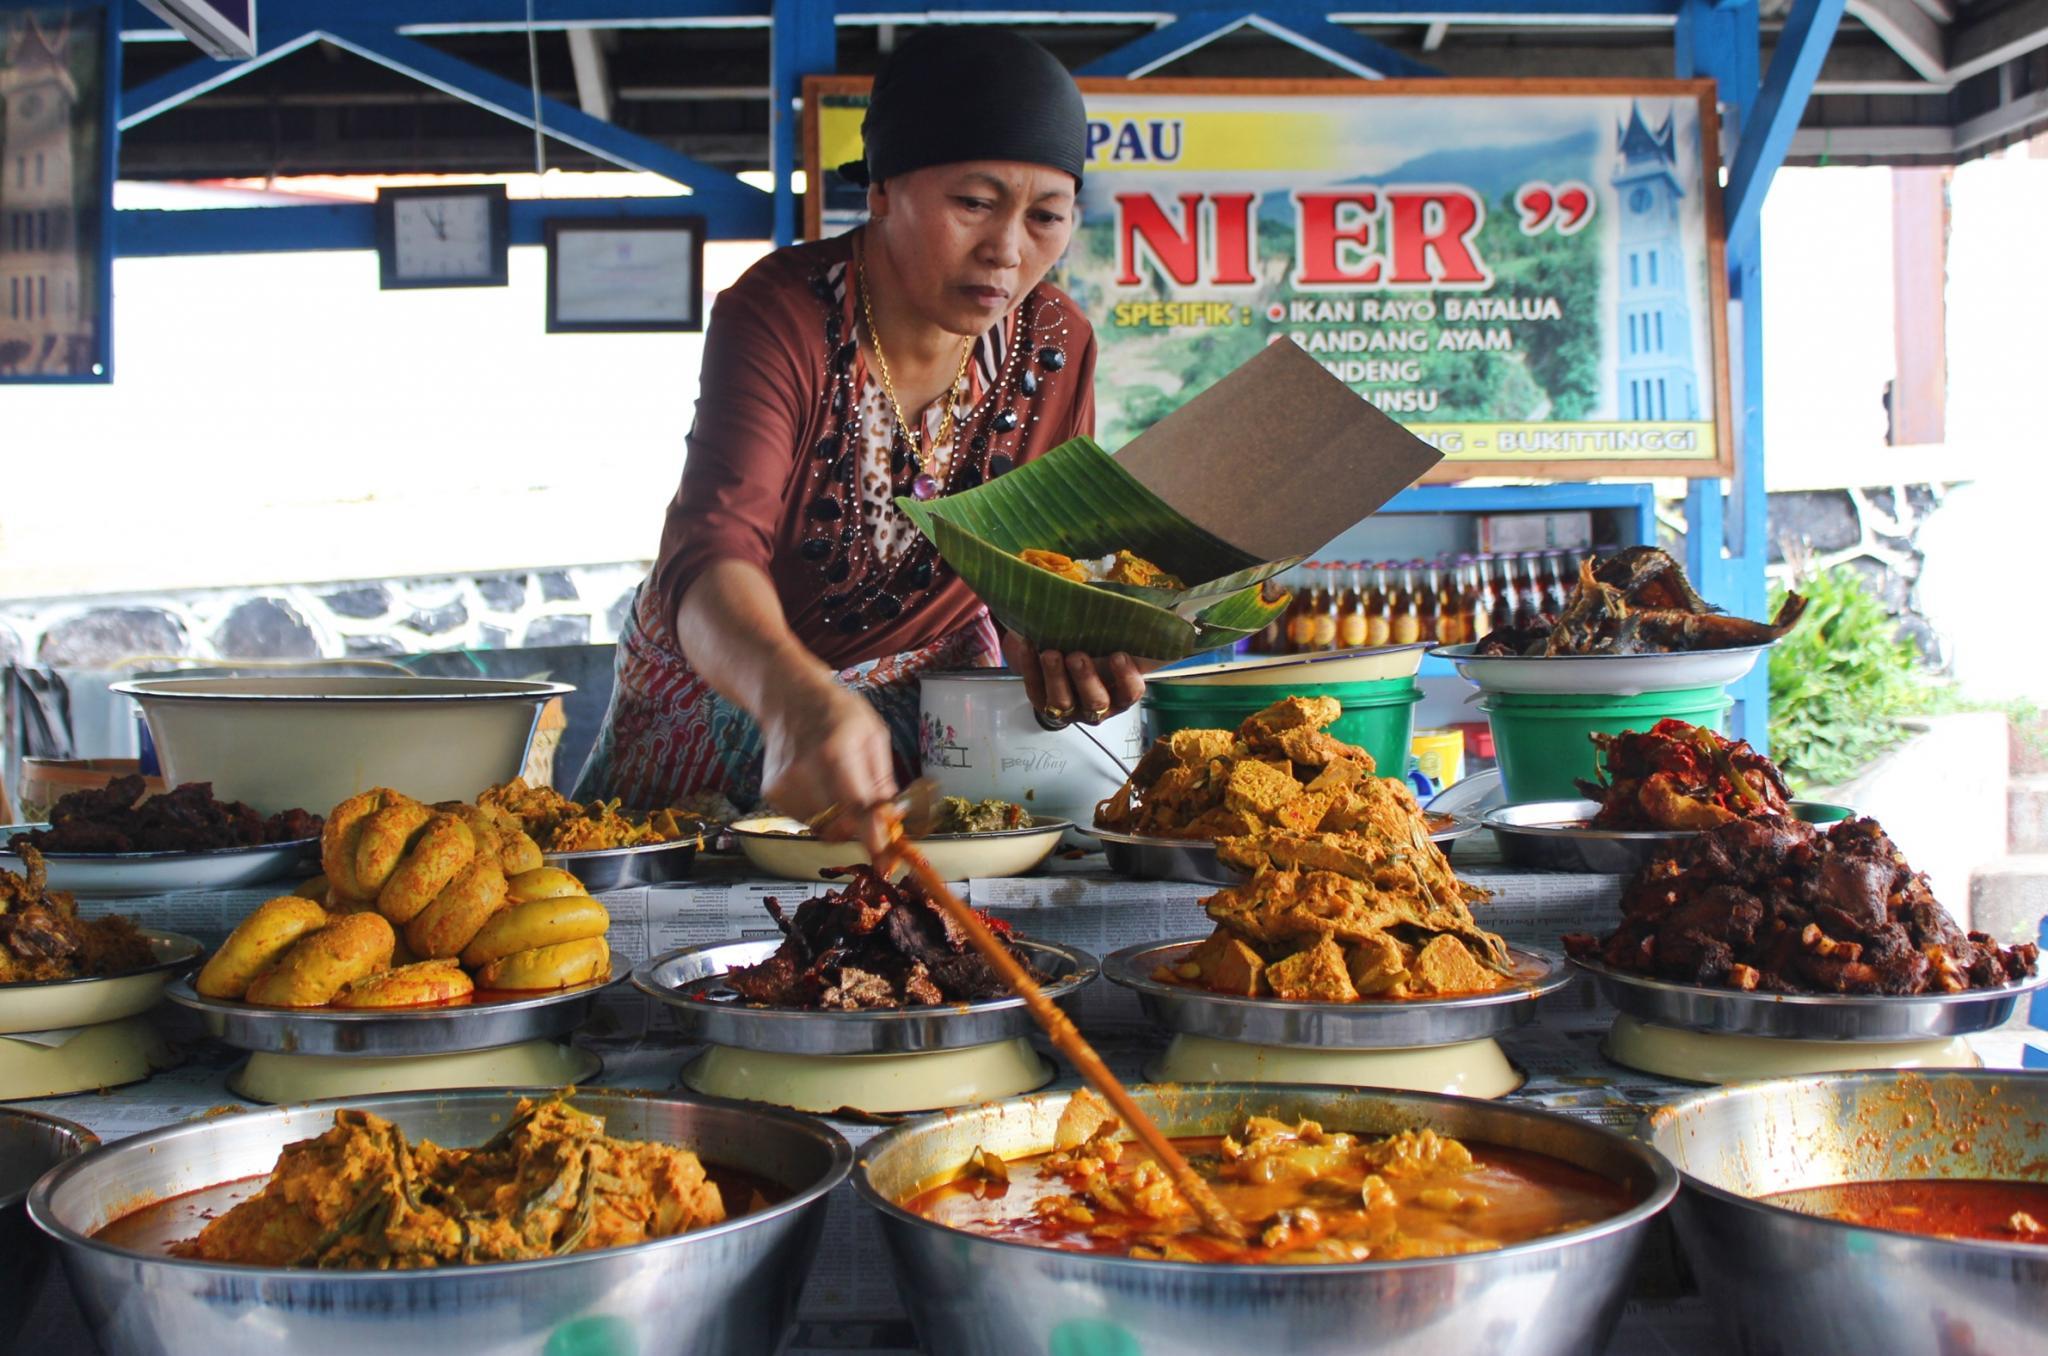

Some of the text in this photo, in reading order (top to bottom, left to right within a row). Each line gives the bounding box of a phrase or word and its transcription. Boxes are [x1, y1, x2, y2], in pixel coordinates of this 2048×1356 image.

[1114, 190, 1257, 286] NI
[1294, 190, 1486, 285] ER
[1114, 303, 1232, 327] SPESIFIK
[1290, 297, 1562, 322] IKAN RAYO BATALUA
[1437, 328, 1513, 350] AYAM
[1498, 429, 1698, 453] BUKITTINGGI
